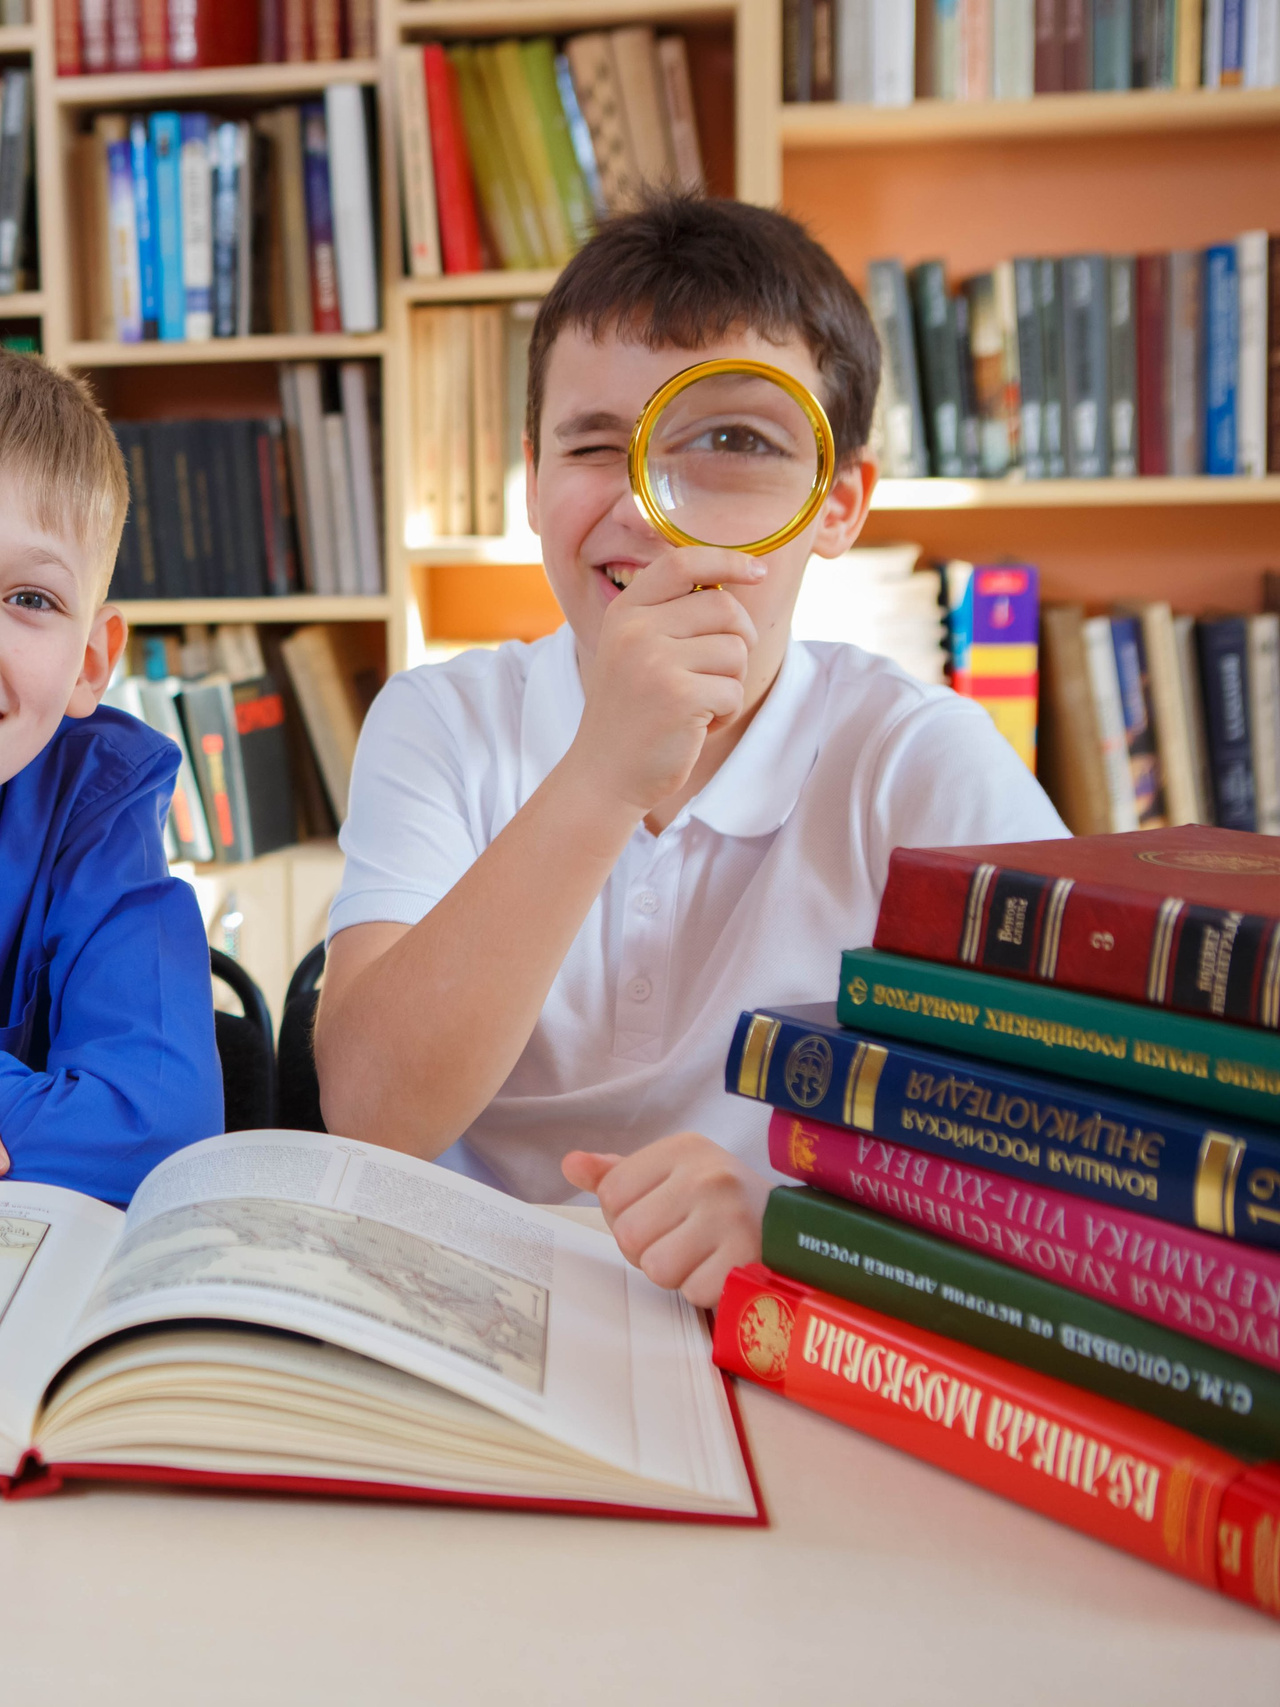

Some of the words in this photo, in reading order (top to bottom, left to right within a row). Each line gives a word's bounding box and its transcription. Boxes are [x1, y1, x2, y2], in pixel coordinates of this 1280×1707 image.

[1090, 931, 1115, 951] 3
[872, 982, 980, 1026] МОНАРХОВ
[983, 1006, 1127, 1060] РОССИЙСКИХ
[1133, 1038, 1211, 1079] БРАКИ
[901, 1107, 1040, 1167] РОССИЙСКАЯ
[905, 1069, 1165, 1168] ЭНЦИКЛОПЕДИЯ
[857, 1134, 929, 1187] ВЕКА
[1046, 1147, 1158, 1201] БОЛЬШАЯ
[1246, 1166, 1280, 1226] 19
[797, 1231, 860, 1266] РОССИИ
[849, 1169, 1118, 1297] ХУДОЖЕСТВЕННАЯ
[863, 1255, 938, 1296] ДРЕВНЕЙ
[1086, 1214, 1280, 1319] КЕРАМИКА
[941, 1282, 1024, 1329] ИСТОРИИ
[1029, 1315, 1054, 1340] ОБ
[1131, 1275, 1280, 1360] РУССКАЯ
[801, 1313, 984, 1440] МОСКОВИЯ
[1059, 1322, 1191, 1390] СОЛОВЬЕВ
[985, 1395, 1161, 1522] ВЕЛИКАЯ
